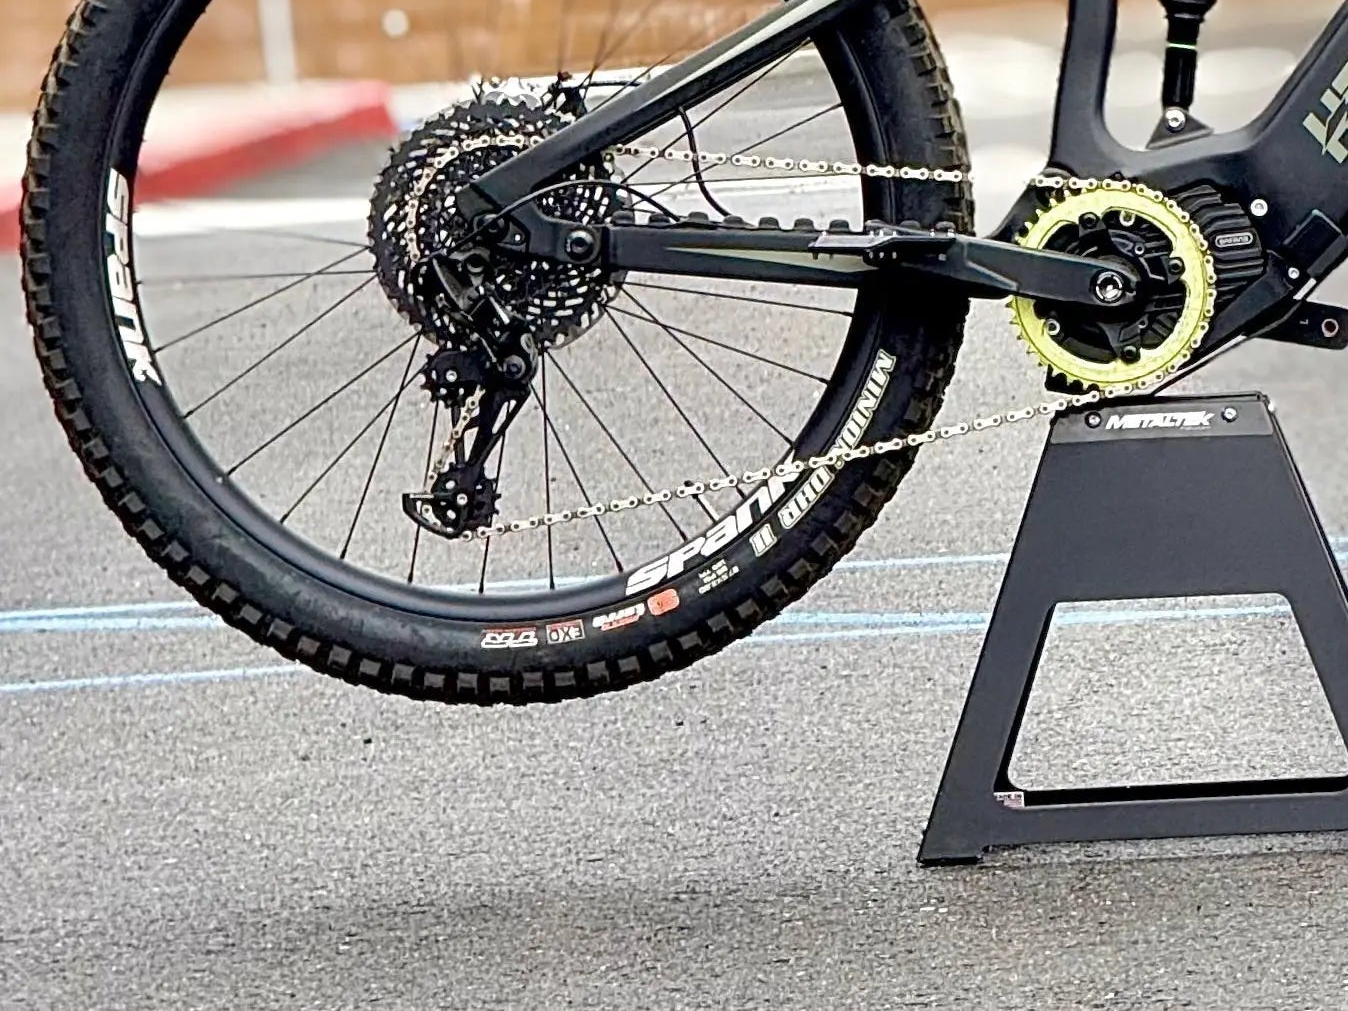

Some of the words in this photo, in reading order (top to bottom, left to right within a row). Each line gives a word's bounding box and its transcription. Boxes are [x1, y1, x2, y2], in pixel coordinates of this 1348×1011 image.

[1104, 409, 1216, 430] METALTEK
[777, 466, 836, 530] DHR
[547, 624, 583, 643] EXO
